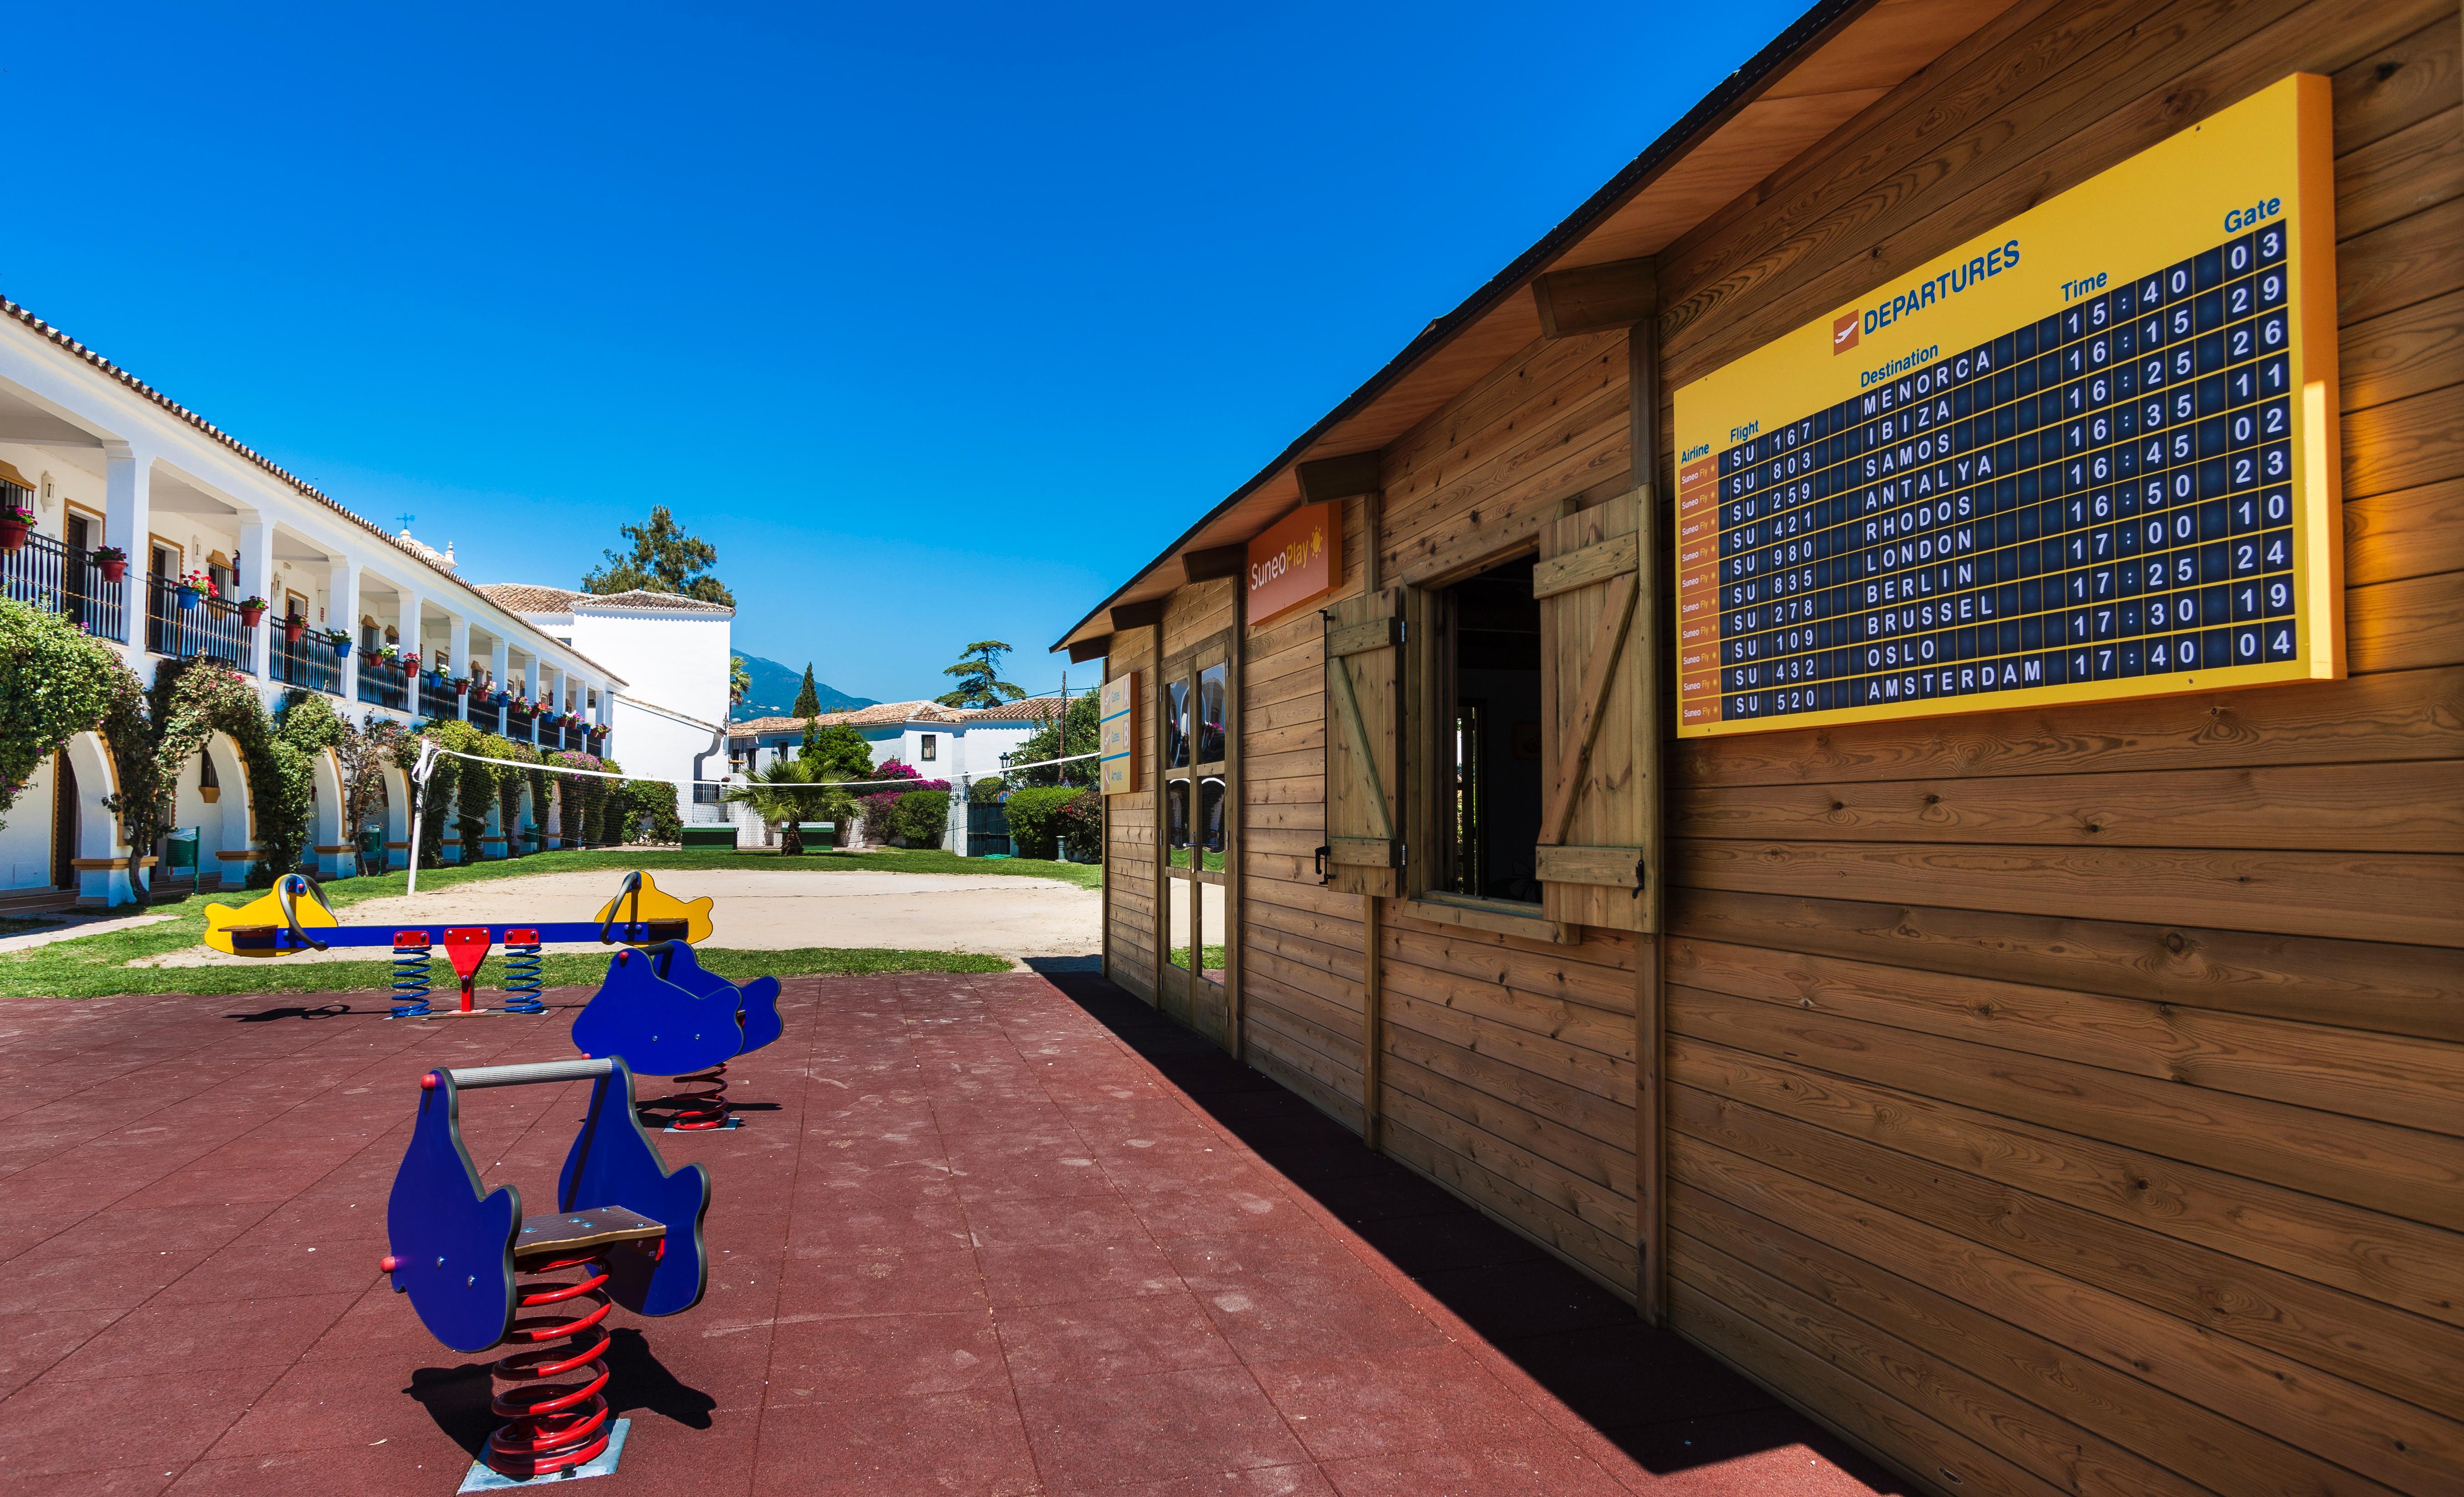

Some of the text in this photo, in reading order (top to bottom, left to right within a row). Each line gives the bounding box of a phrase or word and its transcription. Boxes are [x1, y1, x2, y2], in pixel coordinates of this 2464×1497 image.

[1681, 197, 2281, 464] Airline Flight Destination Time Gate
[1682, 232, 2279, 484] Suneo Fly SU 167 MENORCA 15:40 03
[1864, 239, 2020, 335] DEPARTURES
[1682, 276, 2280, 509] Suneo Fly SU 803 IBIZA 16:15 29
[1682, 524, 1699, 536] Suneo
[1733, 500, 1755, 522] SU
[1773, 482, 1810, 509] 259
[1866, 433, 1949, 477] SAMOS
[2069, 350, 2191, 409] 16:25
[2233, 320, 2281, 356] 26
[1682, 551, 1699, 562] Suneo
[1733, 528, 1755, 549] SU
[1774, 511, 1811, 537] 421
[1866, 455, 1991, 510] ANTALYA
[2070, 394, 2191, 447] 16:35
[2236, 363, 2280, 397] 11
[1251, 539, 1309, 590] SuneoPlay
[1682, 407, 2283, 588] Suneo Fly SU 980 RHODOS 16:45 02
[1682, 451, 2283, 613] Suneo Fly SU 835 LONDON 16:50 23
[1683, 494, 2284, 639] Suneo Fly SU 278 BERLIN 17:00 10
[1683, 540, 2284, 665] Suneo Fly SU 109 BRUSSEL 17:25 24
[1684, 583, 2287, 690] Suneo Fly SU 432 OSLO 17:30 19
[1684, 629, 2291, 717] Suneo Fly SU 520 AMSTERDAM 17:40 04
[1124, 680, 1129, 705] A
[1124, 722, 1128, 747] B
